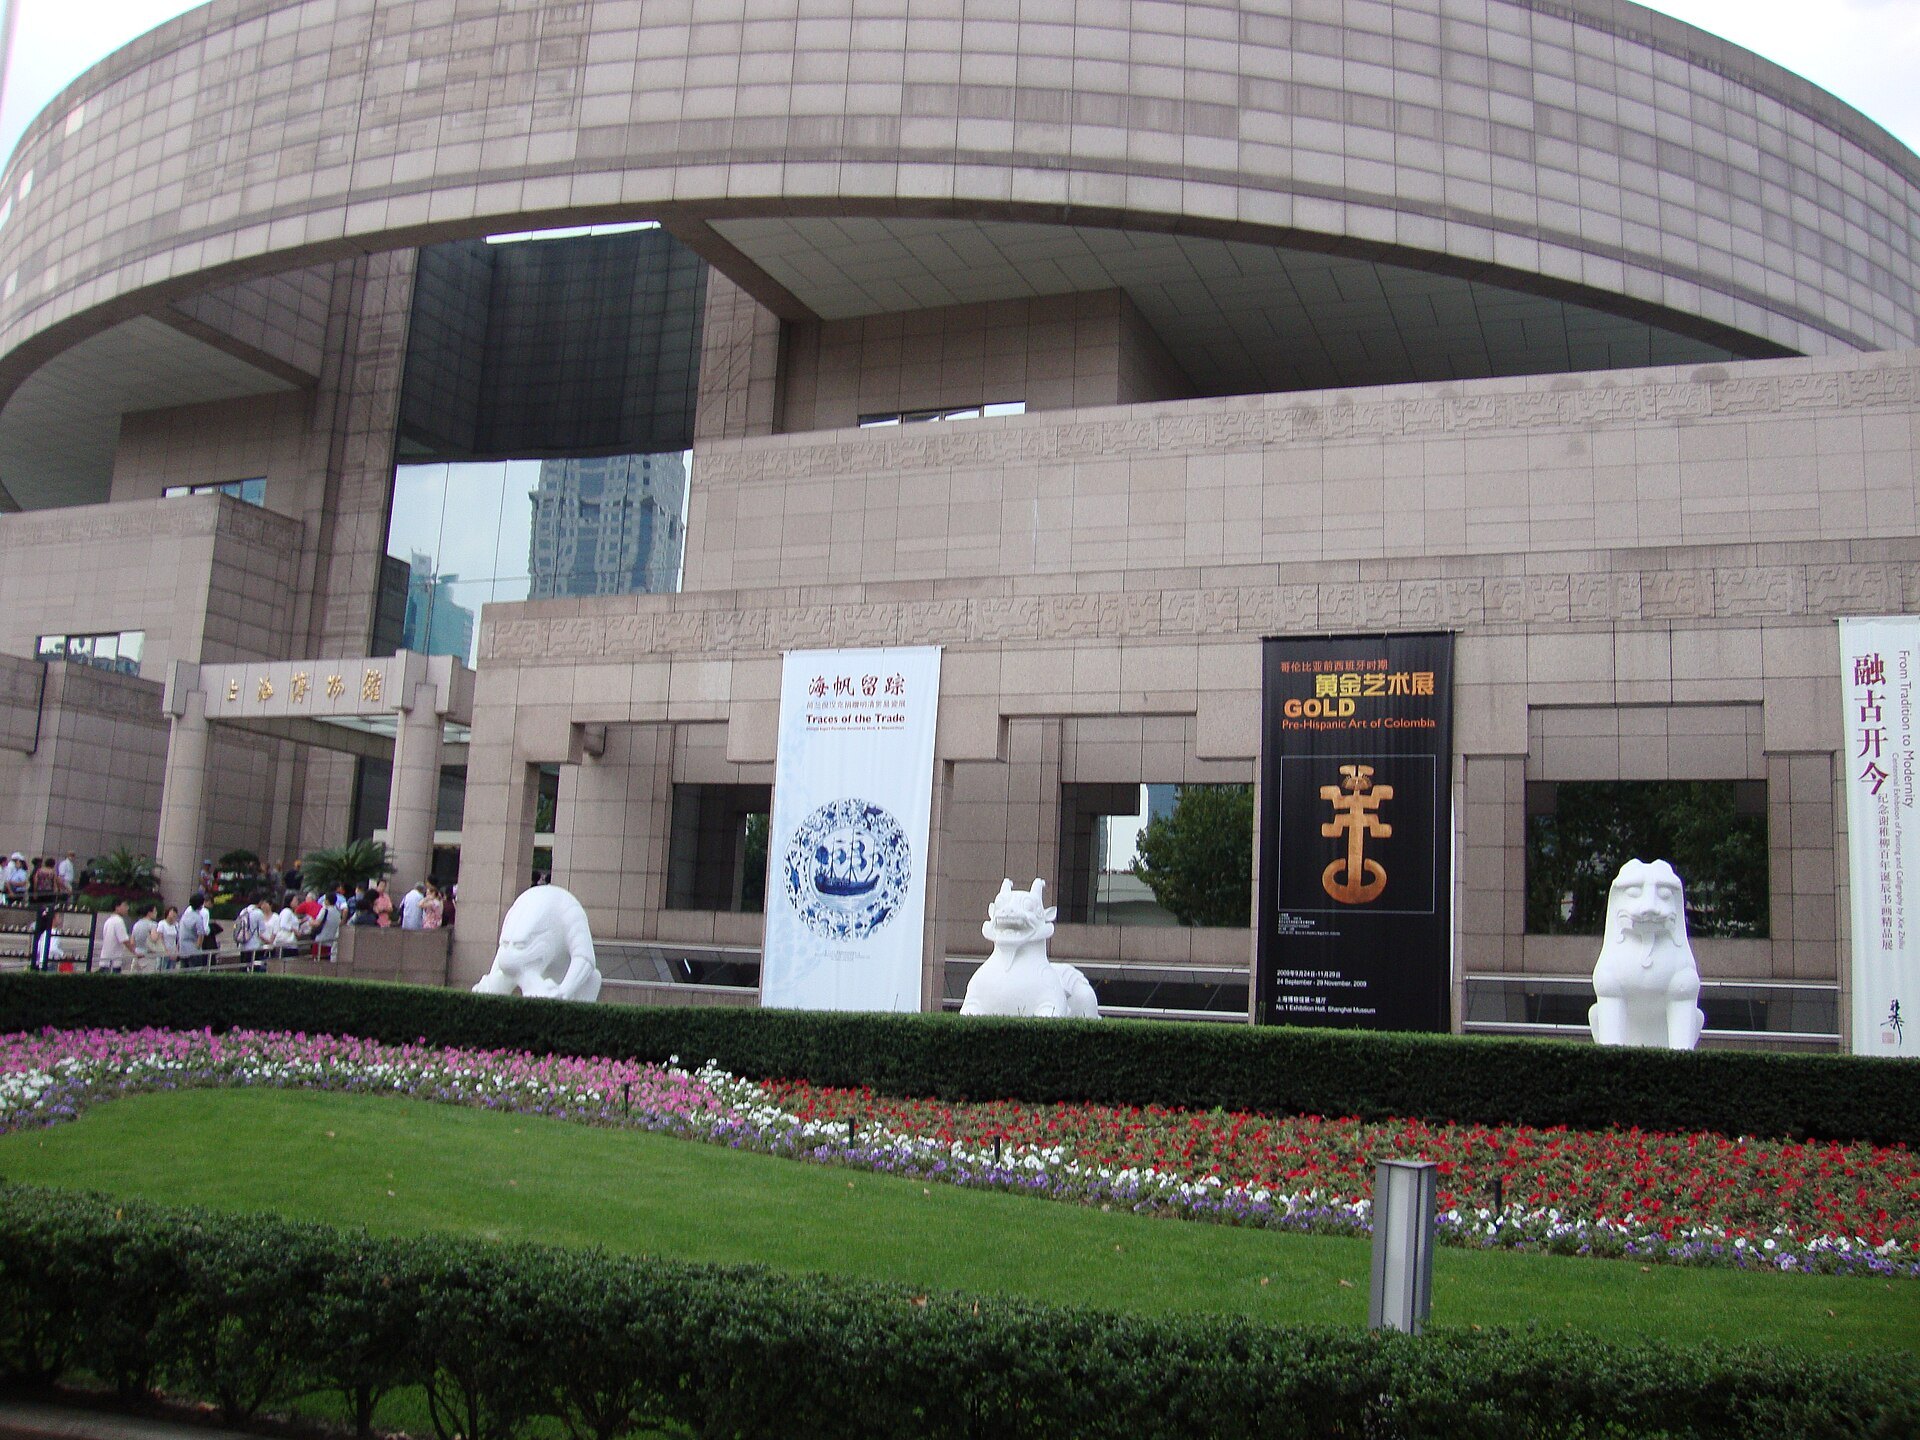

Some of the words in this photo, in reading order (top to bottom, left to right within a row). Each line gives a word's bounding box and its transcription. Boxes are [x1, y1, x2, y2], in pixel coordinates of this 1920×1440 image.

[1281, 659, 1388, 673] 哥伦比亚前西班牙时期
[1899, 650, 1910, 679] From
[809, 672, 905, 698] 海帆留踪
[1315, 671, 1434, 698] 黄金艺术展
[806, 714, 838, 724] Traces
[841, 713, 851, 724] of
[855, 713, 871, 724] the
[875, 713, 905, 723] Trade
[1284, 698, 1355, 718] GOLD
[1900, 681, 1912, 731] Tradition
[1282, 719, 1346, 732] Pre-Hispanic
[1348, 719, 1367, 729] Art
[1370, 718, 1381, 729] of
[1384, 717, 1436, 729] Colombia
[1852, 653, 1890, 795] 融古开今
[1902, 734, 1911, 746] to
[1902, 750, 1915, 808] Modernity
[1893, 788, 1901, 820] Exhibition
